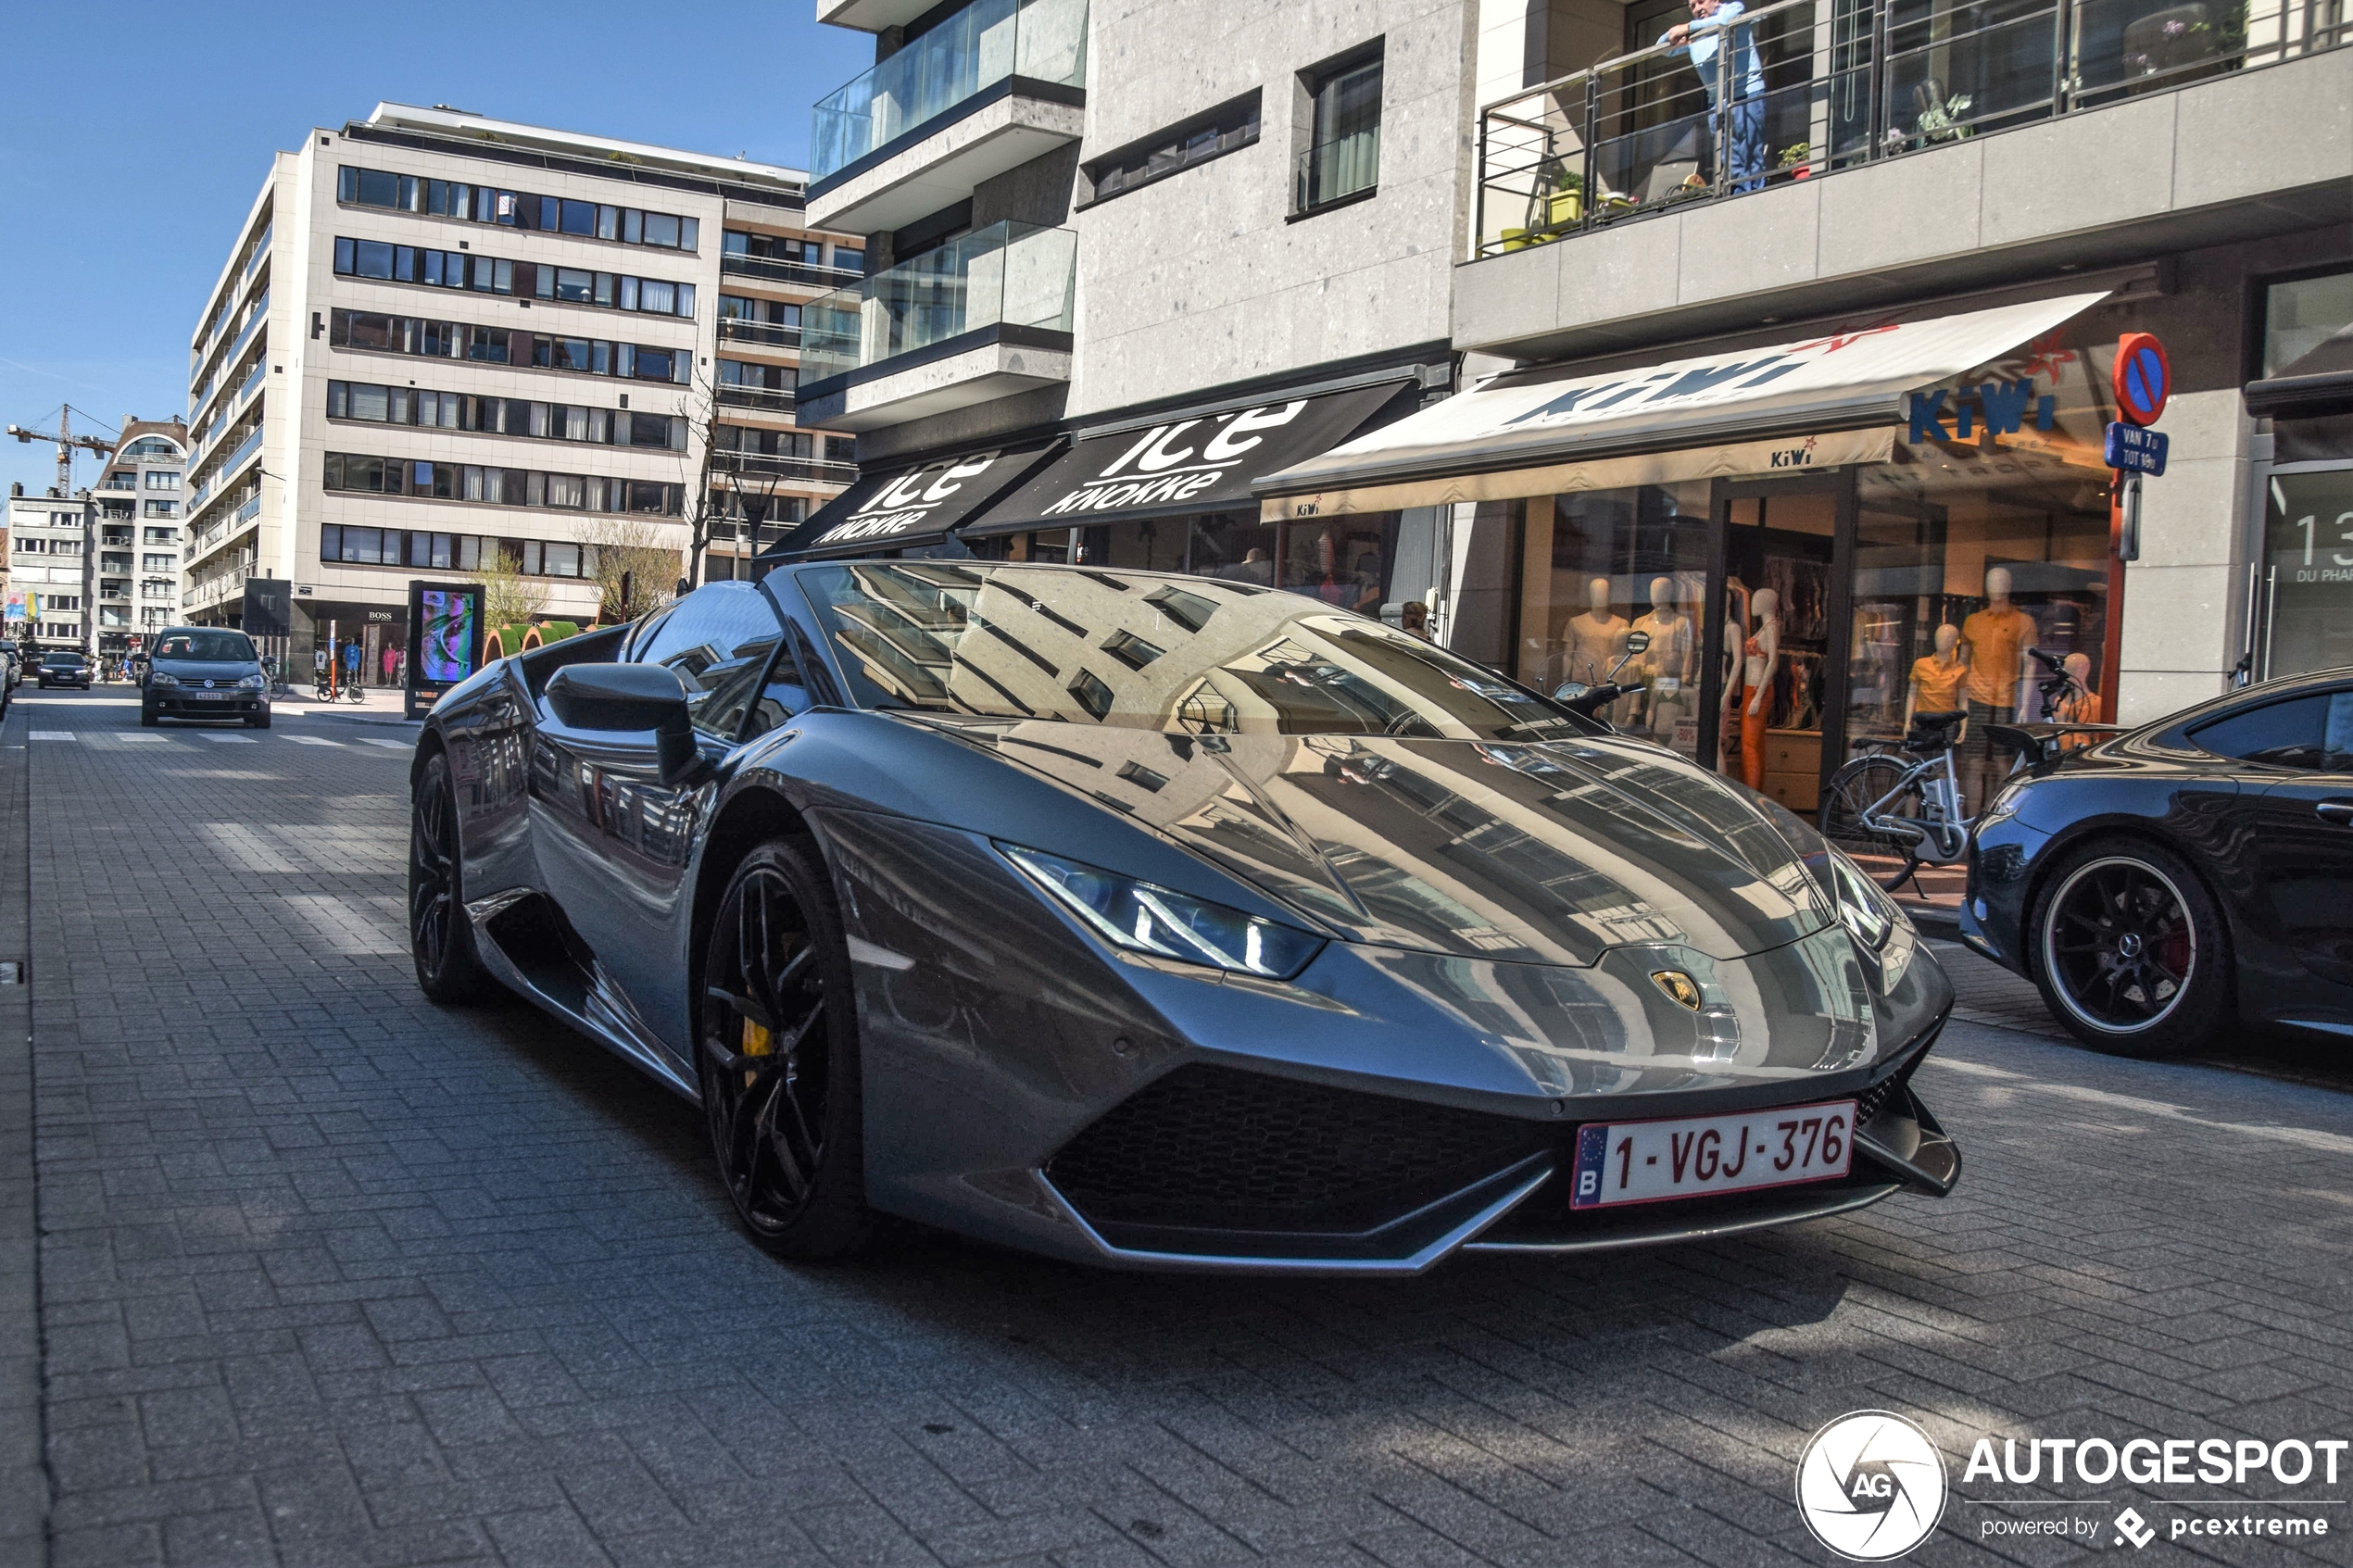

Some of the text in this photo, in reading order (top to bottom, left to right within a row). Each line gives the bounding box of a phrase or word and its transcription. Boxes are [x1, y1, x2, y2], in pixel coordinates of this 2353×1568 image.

[2123, 428, 2142, 445] VAN
[2123, 448, 2140, 466] TOT
[2296, 570, 2317, 583] DU
[369, 611, 392, 620] BOSS
[1616, 1114, 1844, 1190] 1-VGJ-376
[1579, 1170, 1596, 1196] B
